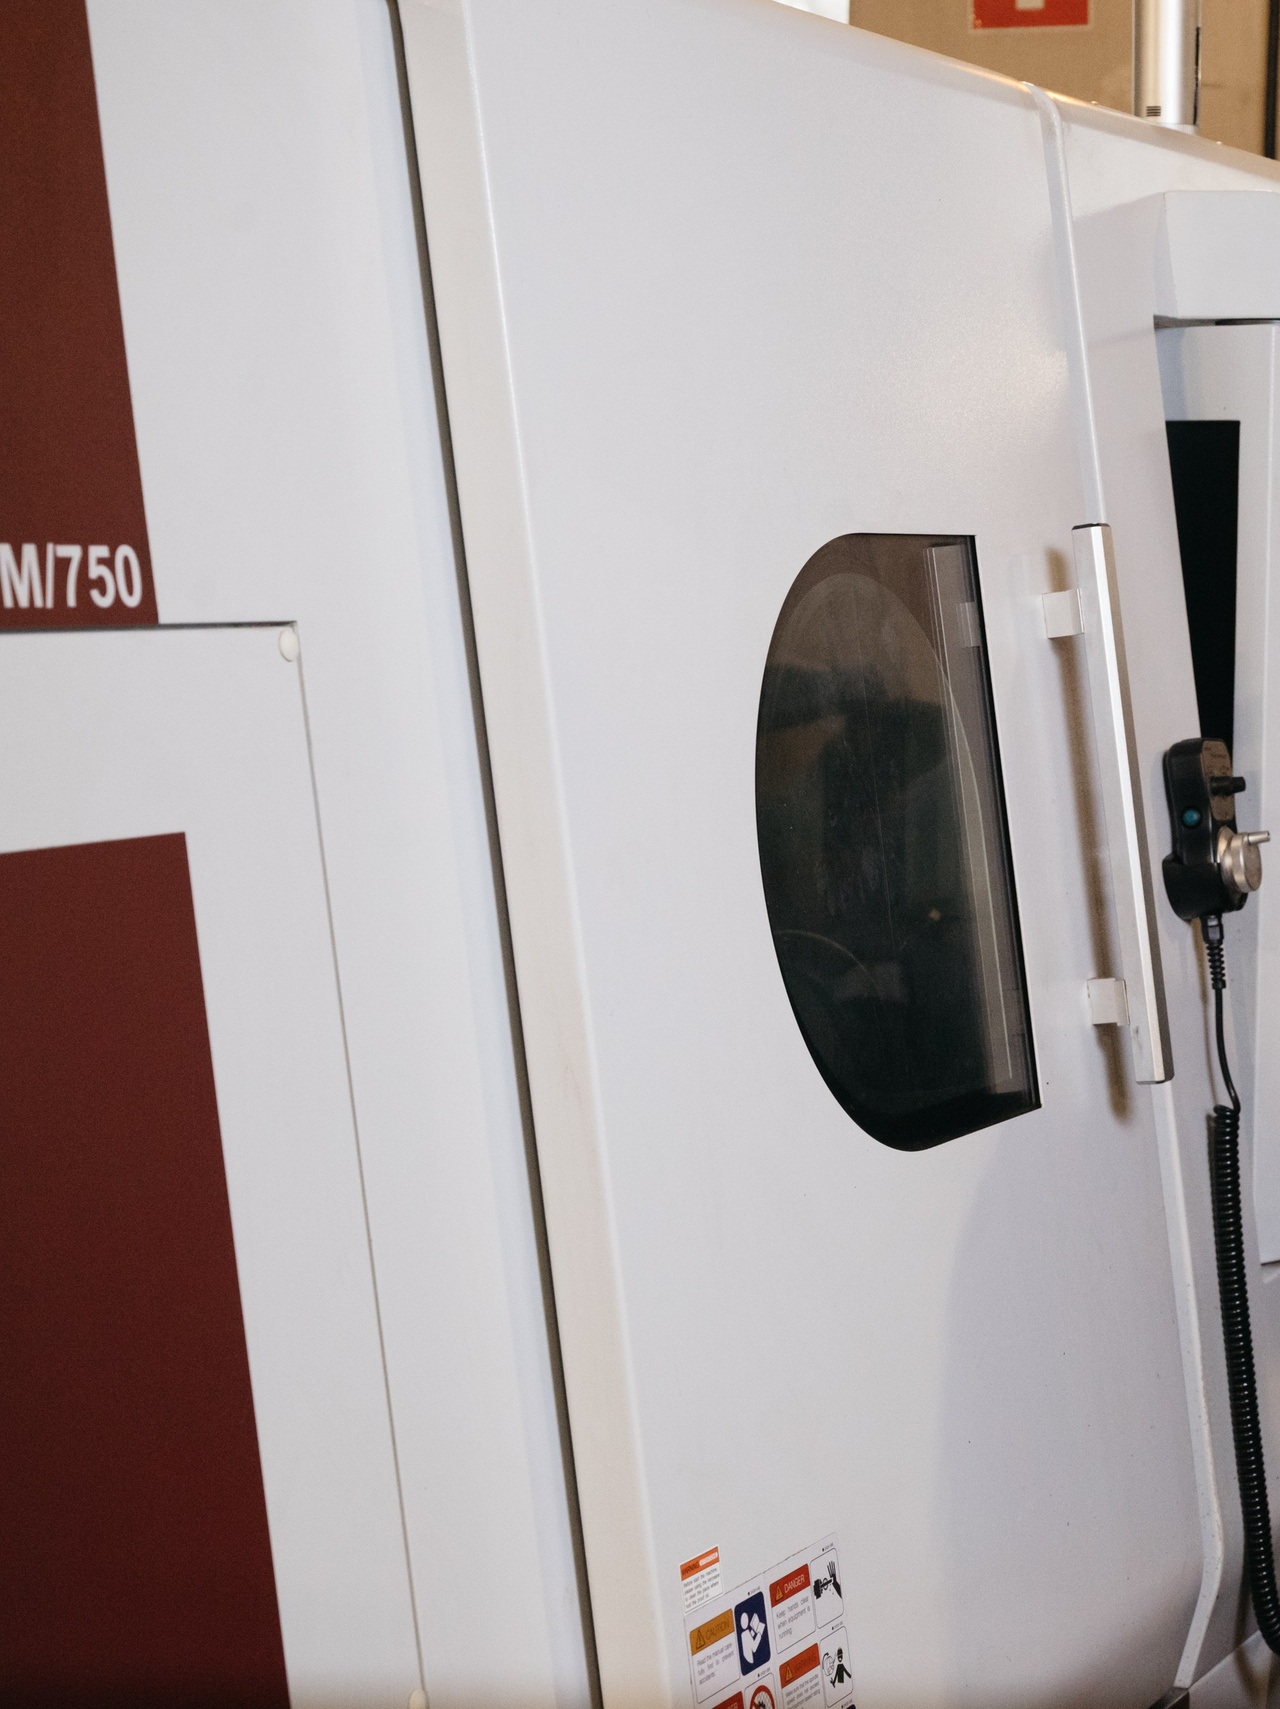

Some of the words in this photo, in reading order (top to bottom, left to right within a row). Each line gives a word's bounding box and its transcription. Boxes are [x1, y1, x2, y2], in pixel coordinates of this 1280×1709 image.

[784, 1574, 805, 1593] DANGER
[788, 1602, 799, 1611] hands
[800, 1596, 809, 1605] clear
[777, 1619, 787, 1629] when
[788, 1608, 806, 1623] equipment
[706, 1619, 730, 1640] CAUTION
[697, 1657, 706, 1666] Read
[713, 1649, 724, 1658] manual
